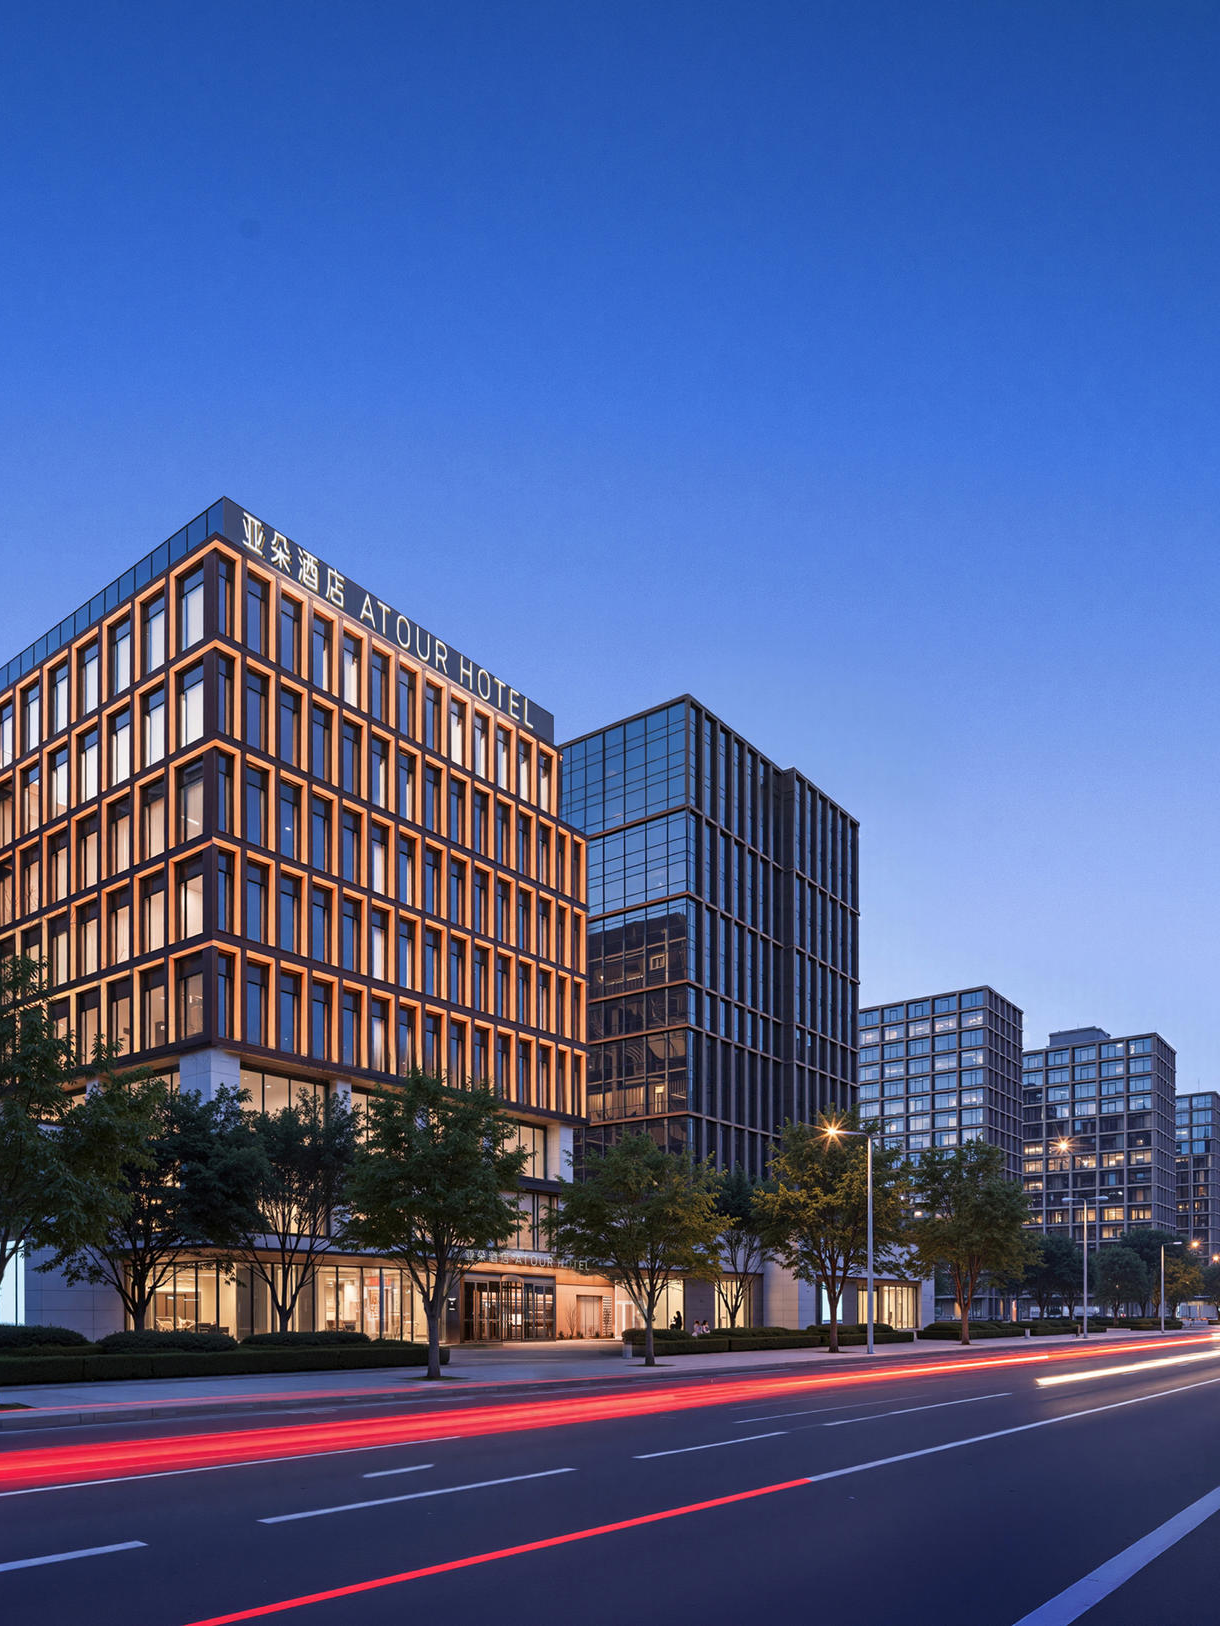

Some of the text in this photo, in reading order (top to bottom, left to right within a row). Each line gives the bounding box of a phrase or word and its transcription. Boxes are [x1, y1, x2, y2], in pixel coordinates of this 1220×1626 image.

[242, 512, 345, 607] 亚朵酒店
[359, 593, 533, 729] ATOUR HOTEL
[515, 1254, 553, 1267] ATOUR
